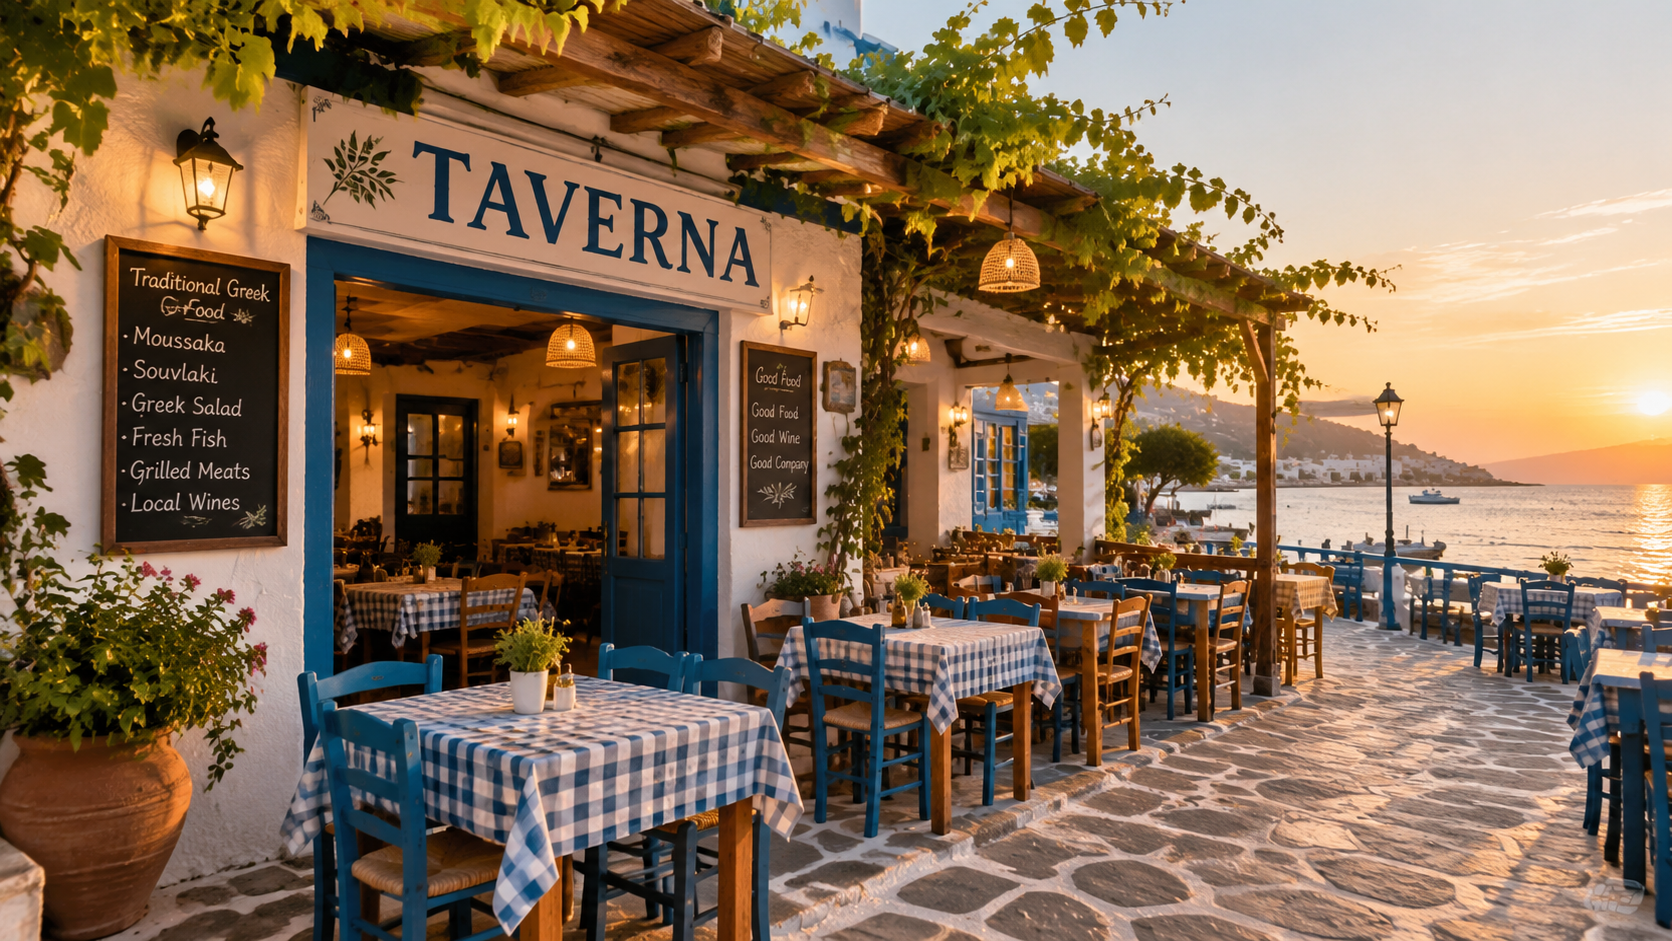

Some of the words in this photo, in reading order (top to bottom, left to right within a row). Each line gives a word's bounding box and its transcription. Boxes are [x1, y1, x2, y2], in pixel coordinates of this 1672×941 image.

[412, 140, 760, 288] TAVERNA
[130, 267, 221, 296] Traditional
[227, 279, 271, 302] Greek
[133, 325, 226, 354] Moussaka
[133, 359, 218, 384] Souvlaki
[755, 366, 779, 385] Good
[131, 392, 186, 415] Greek
[192, 396, 243, 417] Salad
[751, 401, 775, 418] Good
[779, 404, 799, 420] Food
[132, 426, 183, 447] Fresh
[191, 428, 227, 448] Fish
[751, 428, 775, 444] Good
[778, 430, 801, 444] Wine
[130, 459, 191, 486] Grilled
[198, 461, 251, 480] Meats
[750, 454, 773, 470] Good
[130, 492, 181, 512] Local
[188, 492, 240, 511] Wines
